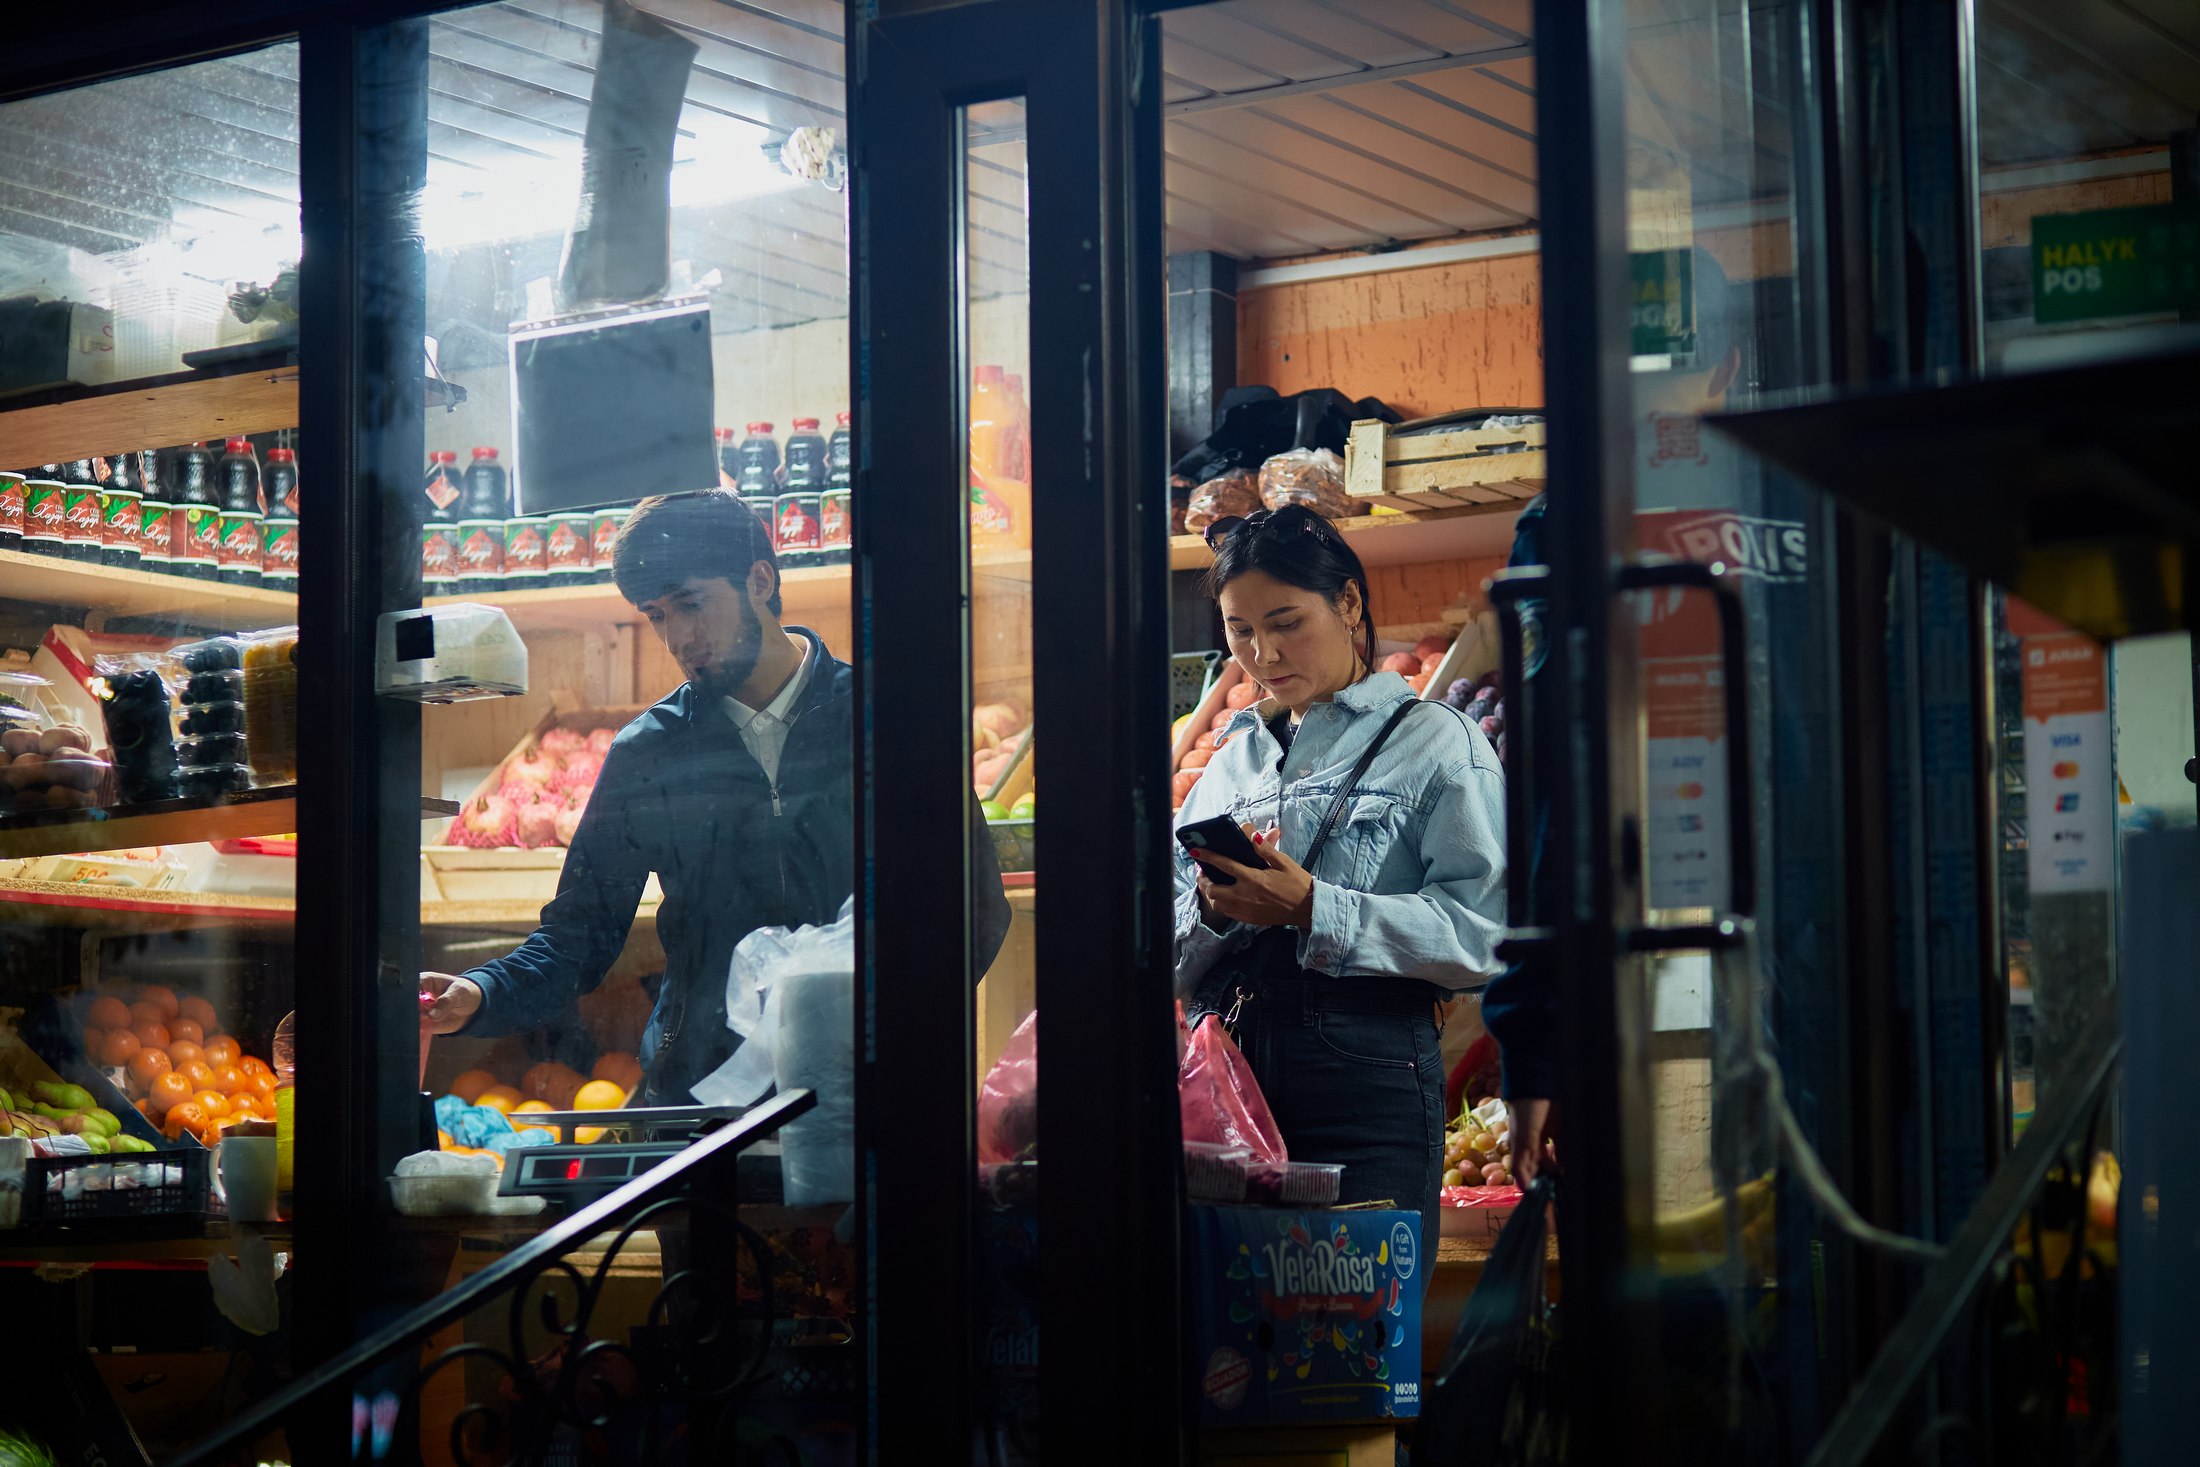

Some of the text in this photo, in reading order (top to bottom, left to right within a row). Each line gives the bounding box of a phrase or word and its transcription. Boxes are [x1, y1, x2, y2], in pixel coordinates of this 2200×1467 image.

[2042, 237, 2137, 269] HALYK
[2042, 266, 2102, 294] POS
[2050, 734, 2081, 747] VISA
[1262, 1238, 1374, 1297] VelaRosa
